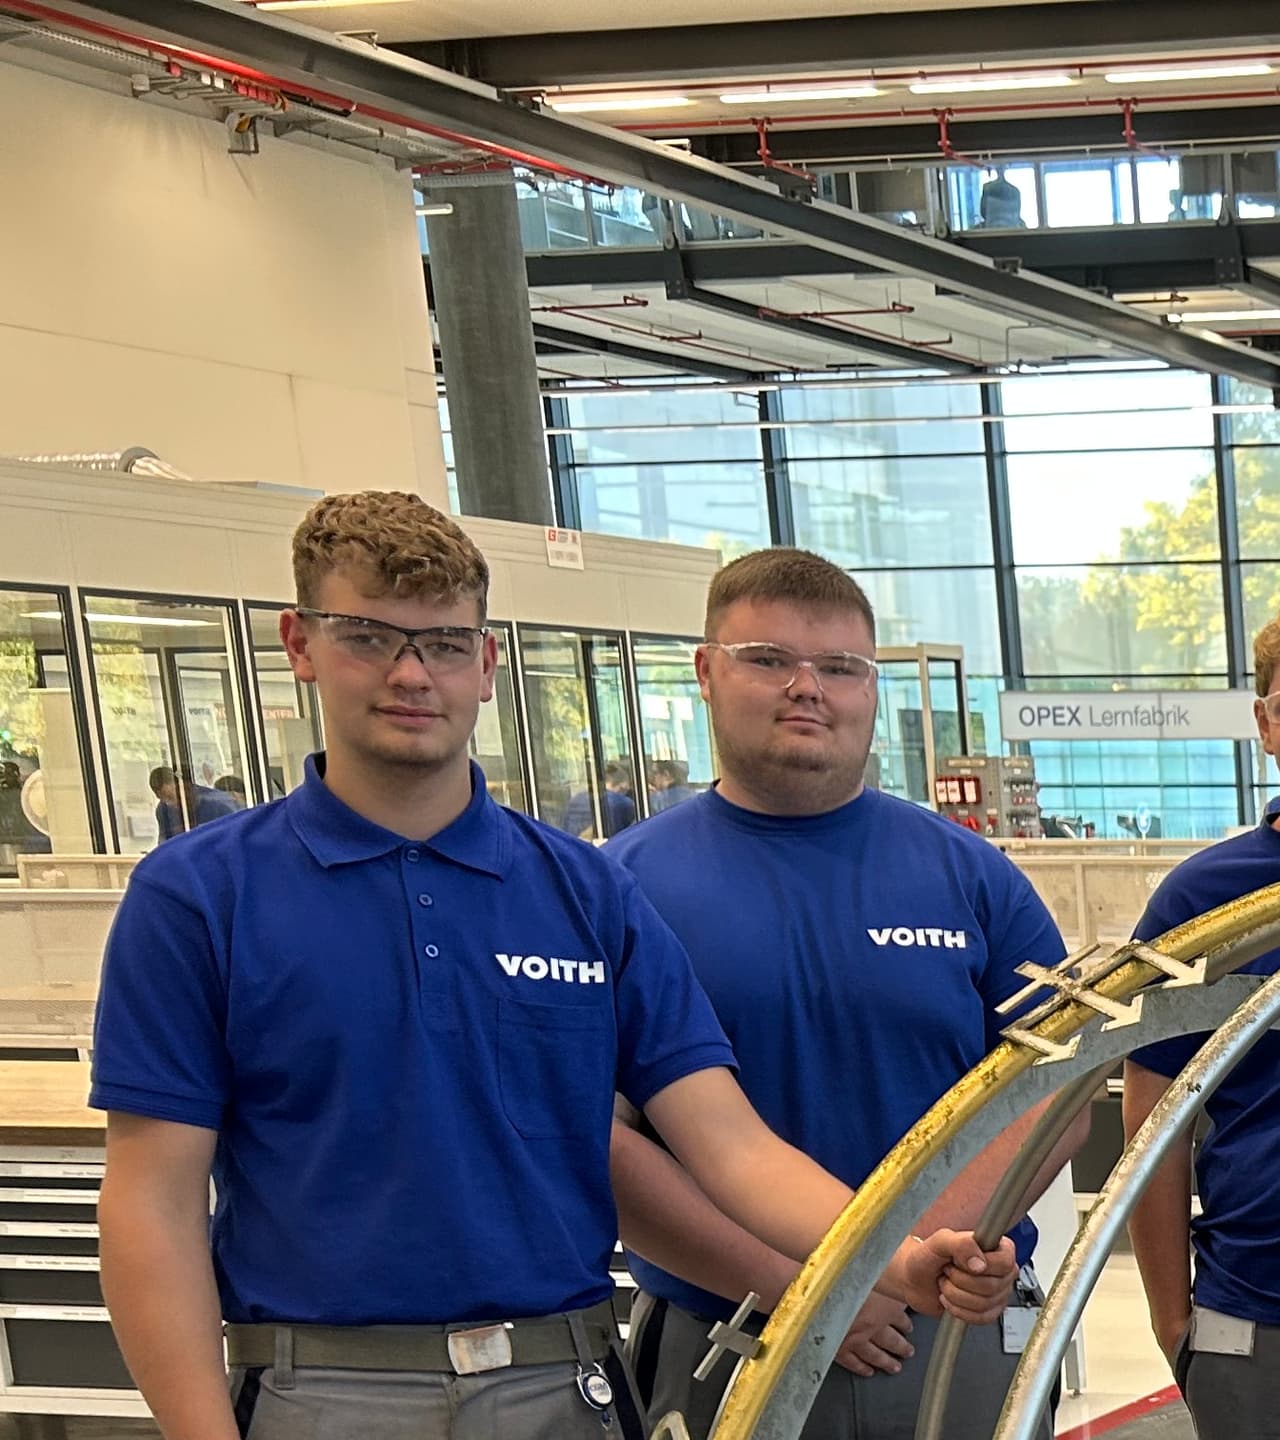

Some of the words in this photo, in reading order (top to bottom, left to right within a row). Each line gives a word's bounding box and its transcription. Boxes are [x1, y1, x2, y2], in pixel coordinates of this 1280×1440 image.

[1018, 706, 1082, 727] OPEX
[1089, 705, 1190, 728] Lernfabrik
[867, 927, 966, 949] VOITH
[495, 953, 605, 984] VOITH
